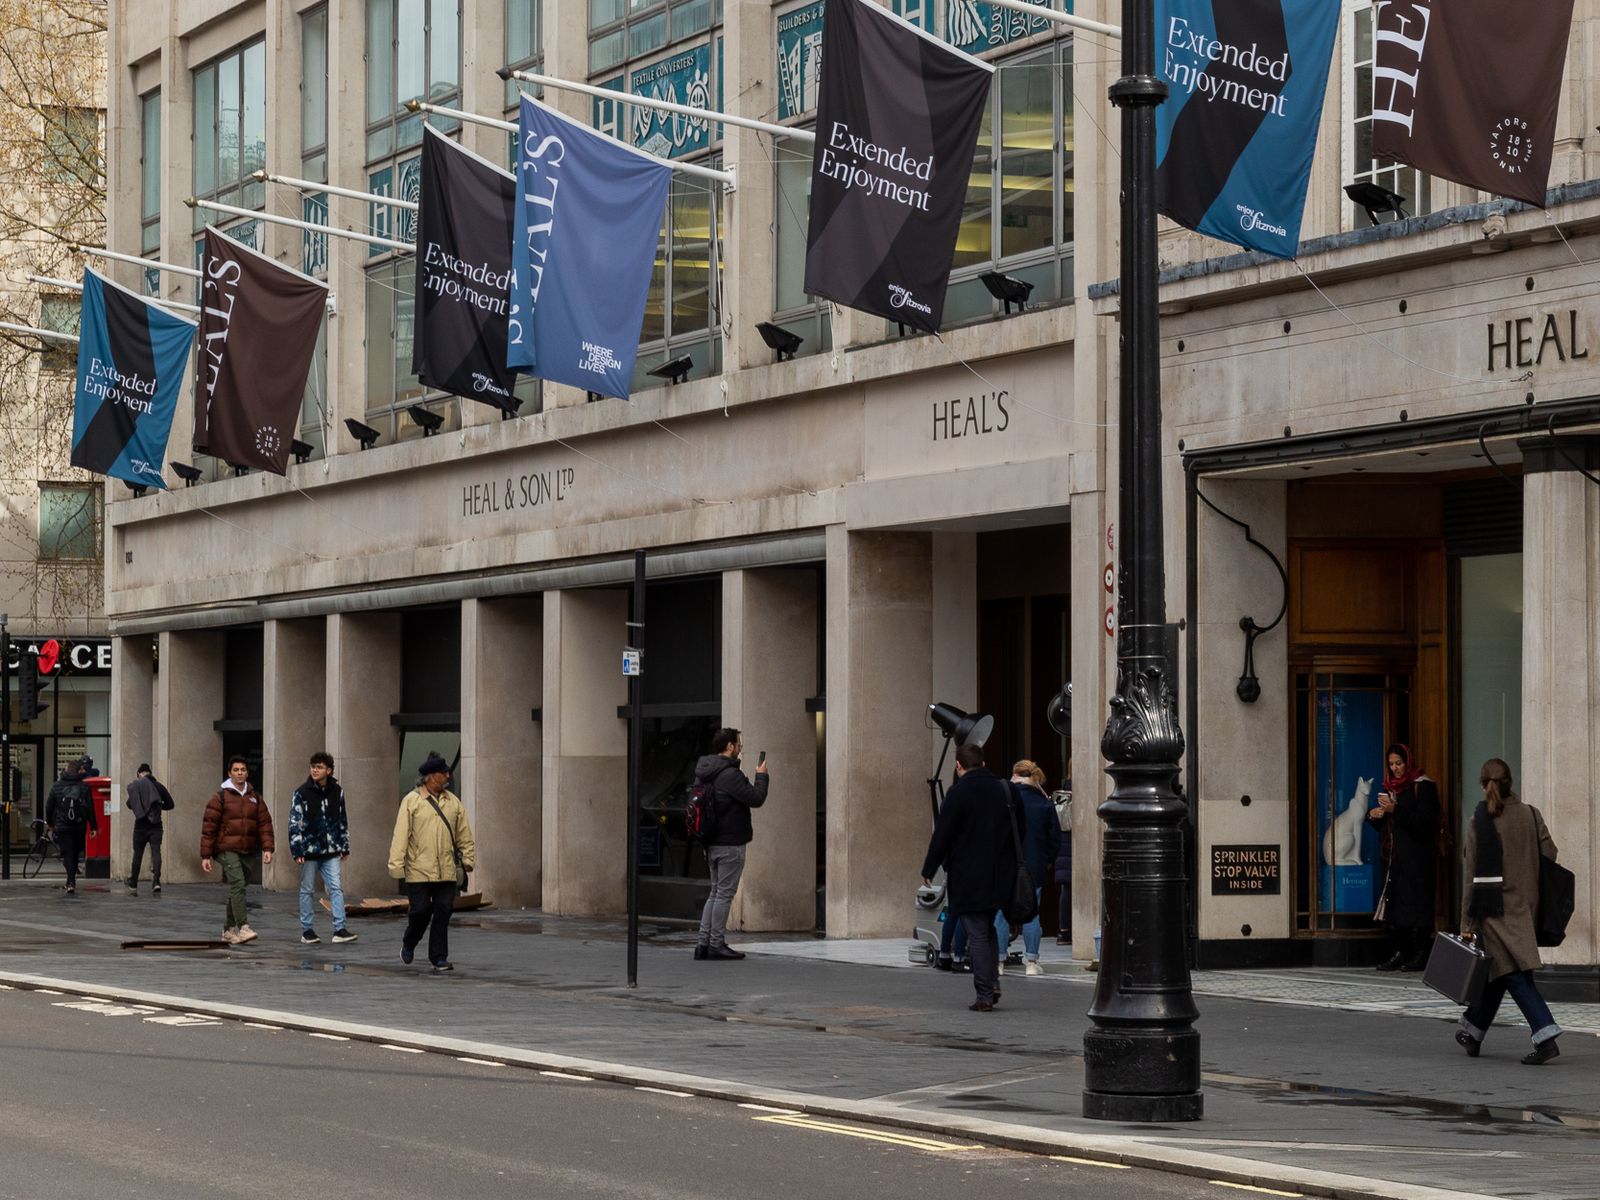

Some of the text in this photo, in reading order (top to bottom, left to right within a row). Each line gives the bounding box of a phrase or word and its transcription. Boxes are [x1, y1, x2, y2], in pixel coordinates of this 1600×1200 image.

[778, 11, 812, 31] BUILDERS
[1168, 16, 1289, 82] Extended
[632, 54, 695, 87] TEXTILE CONVERTERS
[1164, 47, 1288, 117] Enjoyment
[1508, 134, 1520, 146] 18
[830, 121, 934, 181] Extended
[1506, 146, 1519, 157] 10
[819, 148, 932, 212] Enjoyment
[1236, 203, 1255, 218] enjoy
[424, 242, 512, 291] Extended
[888, 283, 905, 298] enjoy
[582, 341, 613, 359] WHERE
[1488, 309, 1588, 372] HEAL
[579, 358, 607, 376] LIVES.
[588, 352, 621, 370] DESIGN
[933, 390, 1009, 441] HEAL'S
[463, 481, 500, 517] HEAL
[504, 478, 515, 510] &
[520, 471, 552, 508] SON
[1214, 851, 1278, 863] SPRINKLER
[1214, 865, 1278, 878] STOP VALVE
[1229, 880, 1263, 889] INSIDE
